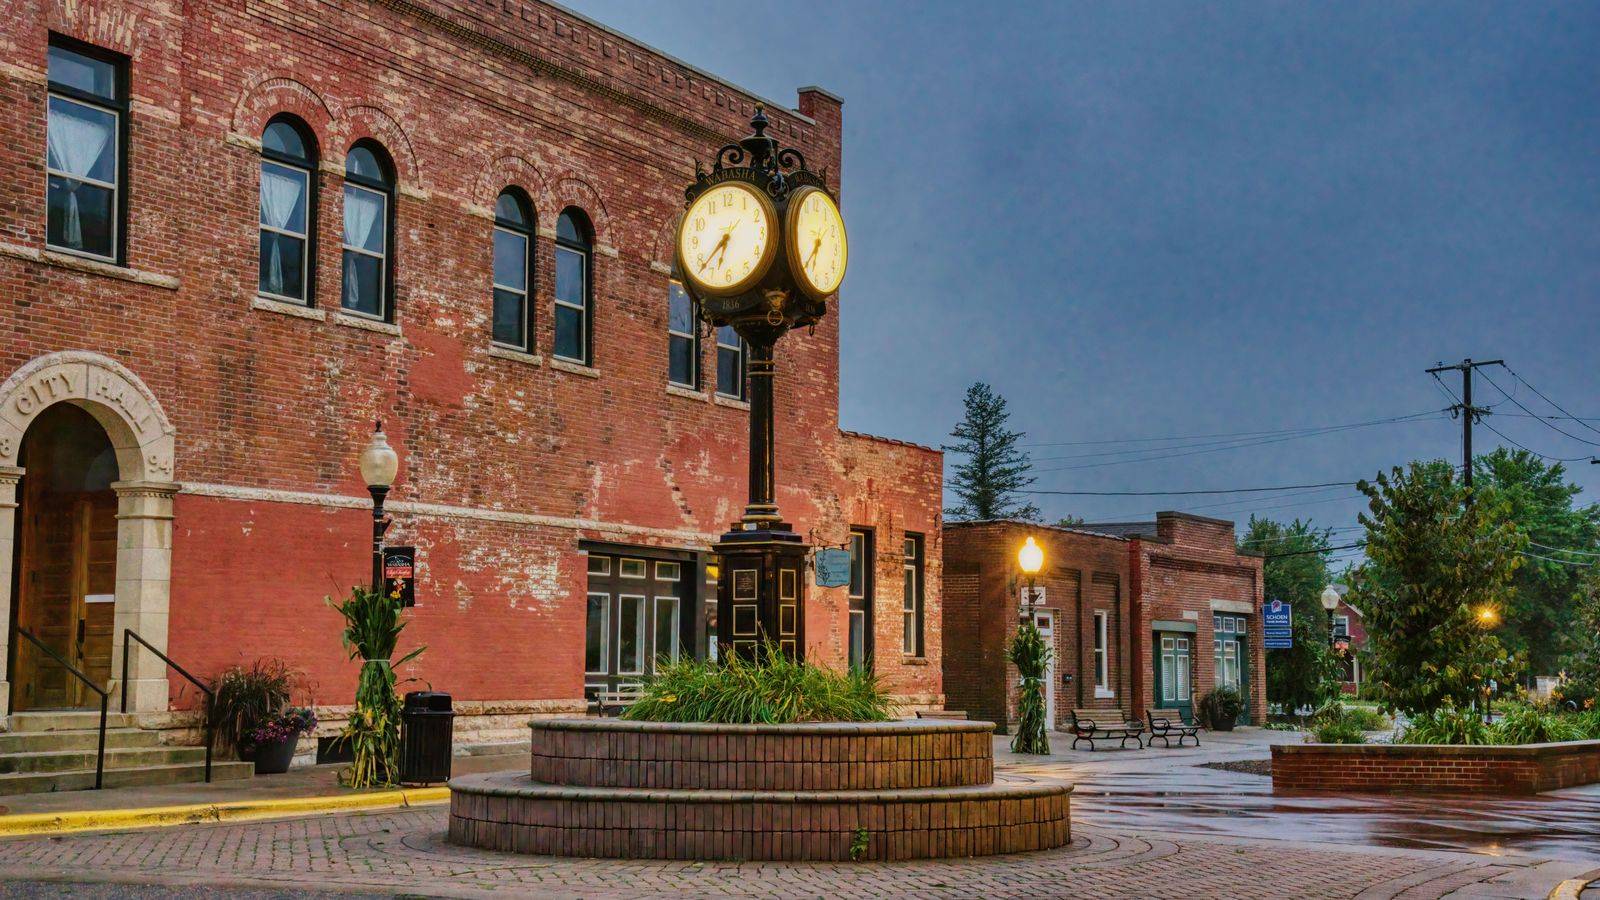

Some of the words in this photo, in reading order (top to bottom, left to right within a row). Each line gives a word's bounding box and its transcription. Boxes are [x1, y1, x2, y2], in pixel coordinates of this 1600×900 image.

[723, 193, 733, 207] 12
[708, 201, 716, 215] 11
[695, 217, 705, 232] 10
[16, 370, 79, 416] CITY
[96, 374, 151, 434] HALL
